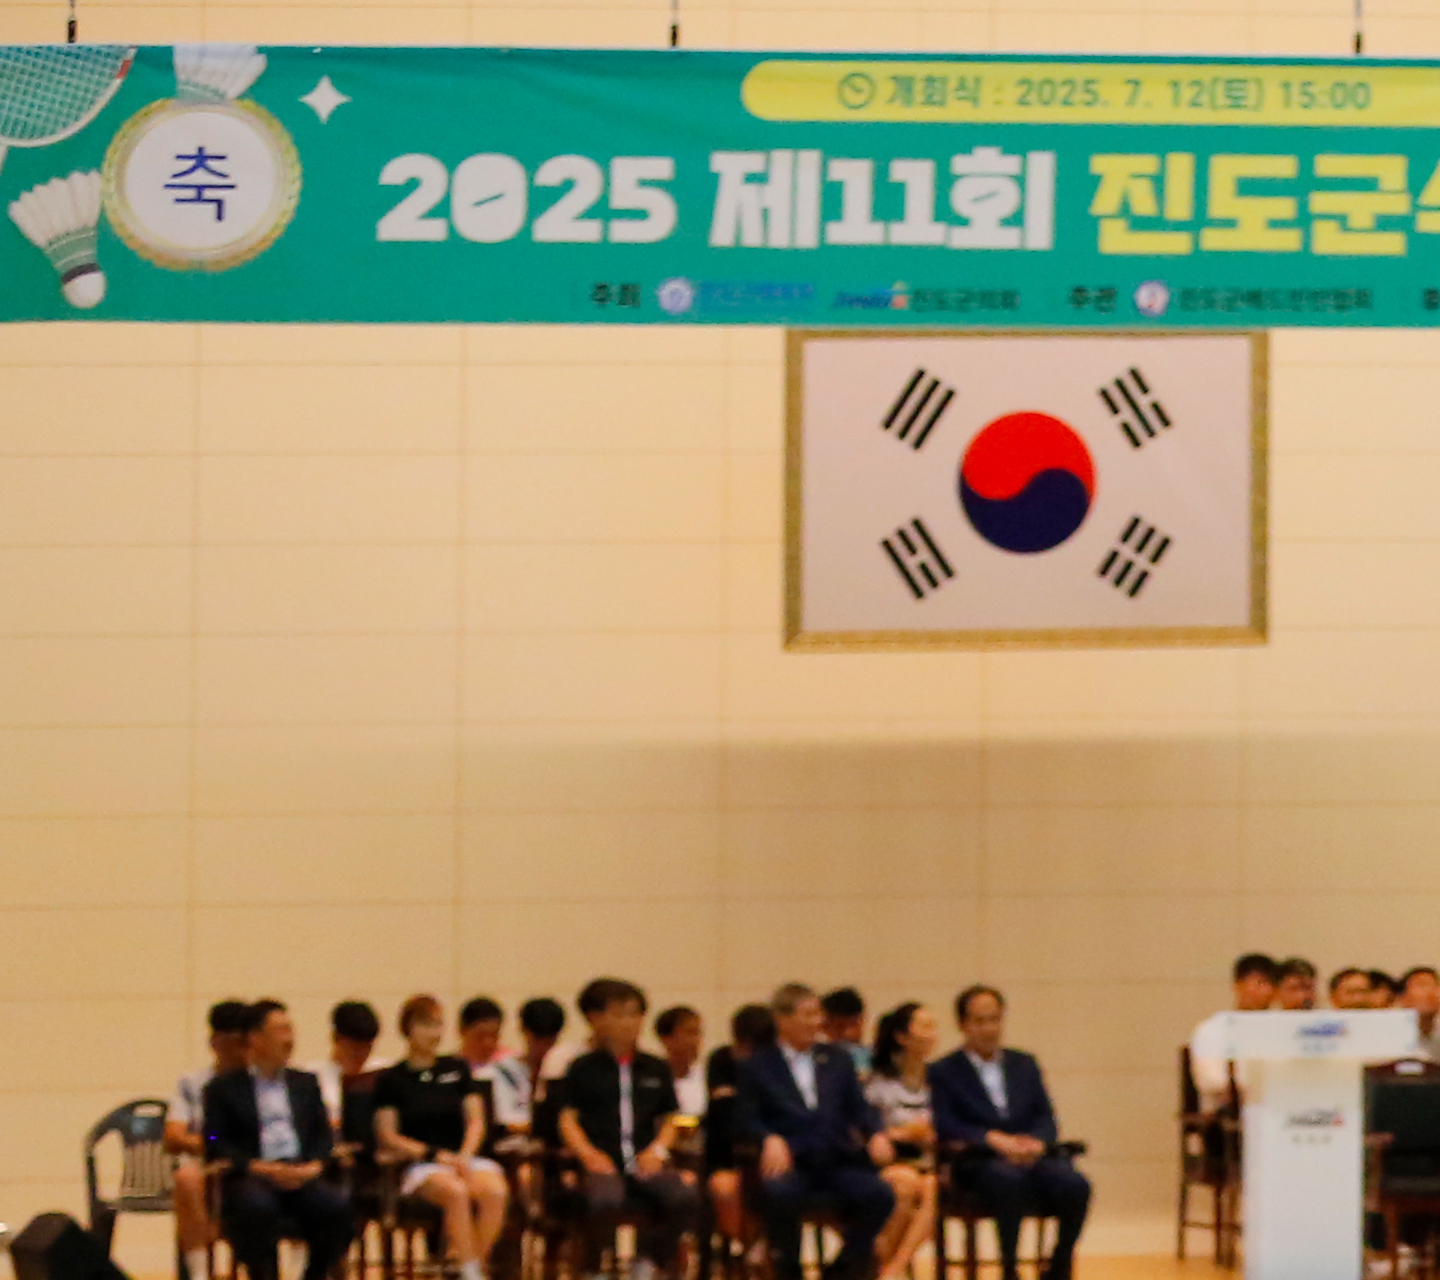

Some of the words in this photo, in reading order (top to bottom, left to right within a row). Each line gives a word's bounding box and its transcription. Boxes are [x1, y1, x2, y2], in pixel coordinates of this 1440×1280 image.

[888, 74, 982, 109] 개회식
[1016, 77, 1110, 108] 2025.
[1170, 76, 1265, 112] 12(토)
[1282, 79, 1372, 111] 15:00
[163, 146, 237, 221] 축
[376, 151, 676, 243] 2025
[707, 146, 1057, 251] 제11회
